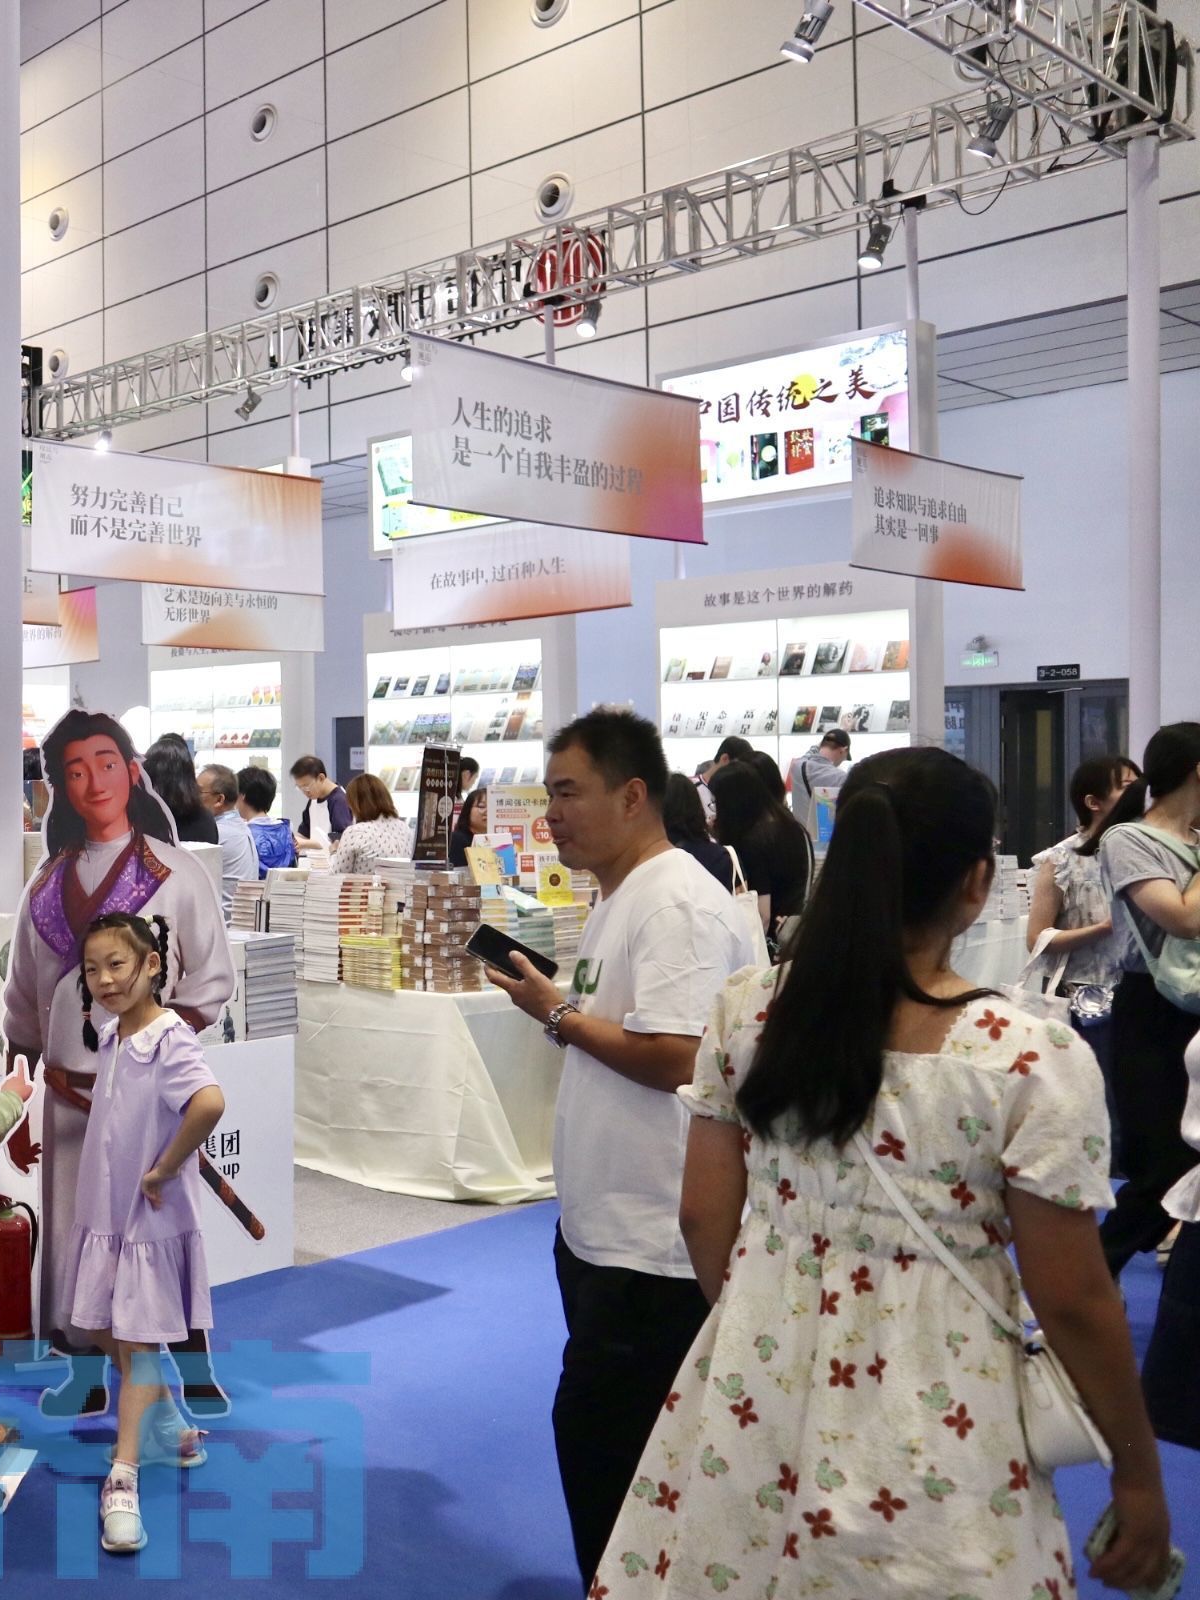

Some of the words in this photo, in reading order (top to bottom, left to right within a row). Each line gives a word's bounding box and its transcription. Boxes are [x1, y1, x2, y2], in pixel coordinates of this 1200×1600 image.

[452, 396, 553, 443] 人生的追求
[451, 435, 644, 494] 是一个自我丰盈的过程
[70, 483, 184, 518] 努力完善自己
[873, 486, 968, 525] 追求知识与追求自由
[70, 514, 202, 548] 而不是完善世界
[874, 513, 940, 544] 其实是一回事
[704, 581, 853, 607] 故事是这个世界的解药
[163, 606, 211, 624] 无形世界
[218, 1162, 240, 1180] up
